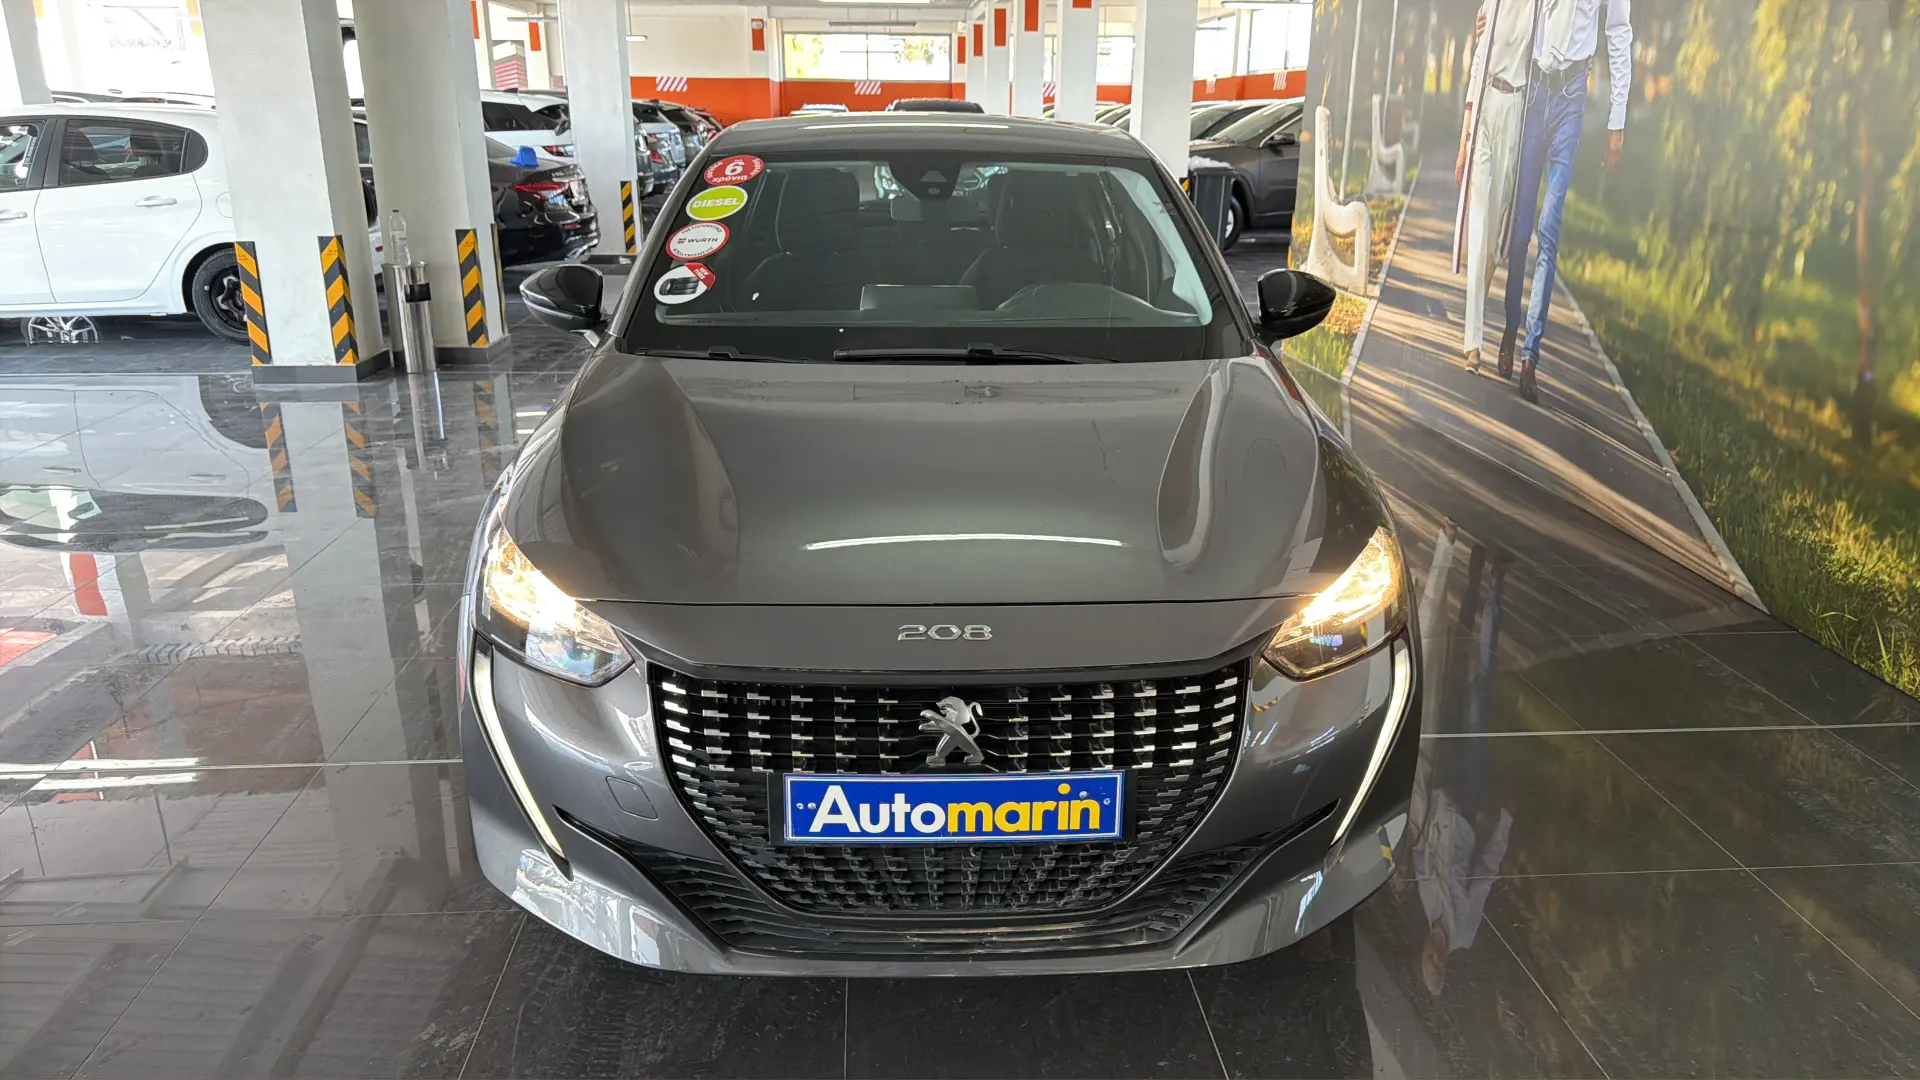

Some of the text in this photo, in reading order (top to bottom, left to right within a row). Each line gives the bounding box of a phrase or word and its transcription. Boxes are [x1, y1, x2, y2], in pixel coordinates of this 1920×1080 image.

[725, 161, 745, 176] 6
[711, 175, 748, 183] χρόνια
[692, 198, 741, 208] DIESEL
[897, 624, 993, 641] 208
[809, 783, 1101, 834] Automarin
